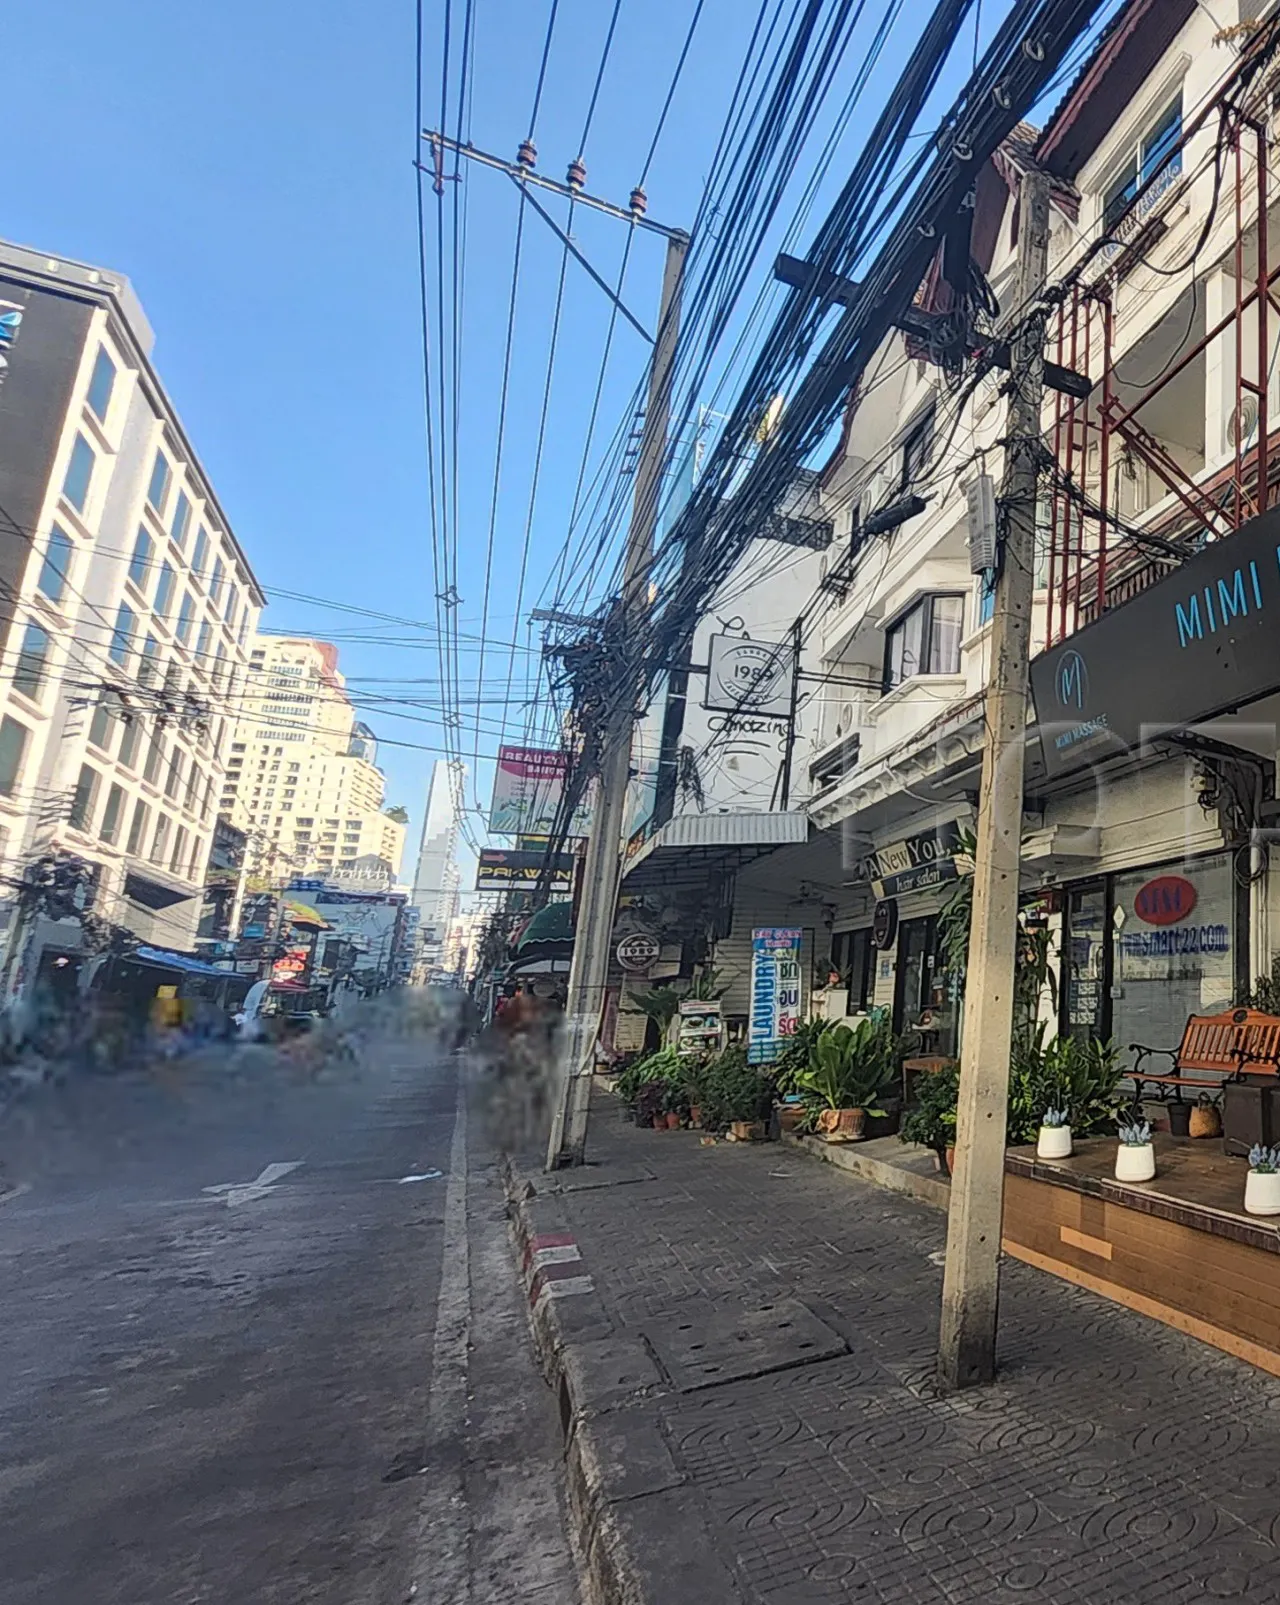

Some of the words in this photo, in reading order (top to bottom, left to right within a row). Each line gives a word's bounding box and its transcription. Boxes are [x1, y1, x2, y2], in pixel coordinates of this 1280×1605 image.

[1174, 560, 1264, 648] MIMI
[734, 664, 774, 682] 1989
[1055, 730, 1073, 749] MIMI
[1072, 712, 1109, 742] MASSAGE
[879, 849, 909, 874] New
[896, 876, 914, 892] hair
[916, 867, 941, 887] salon
[752, 954, 776, 1040] LAUNDRY
[779, 989, 797, 1006] อบ
